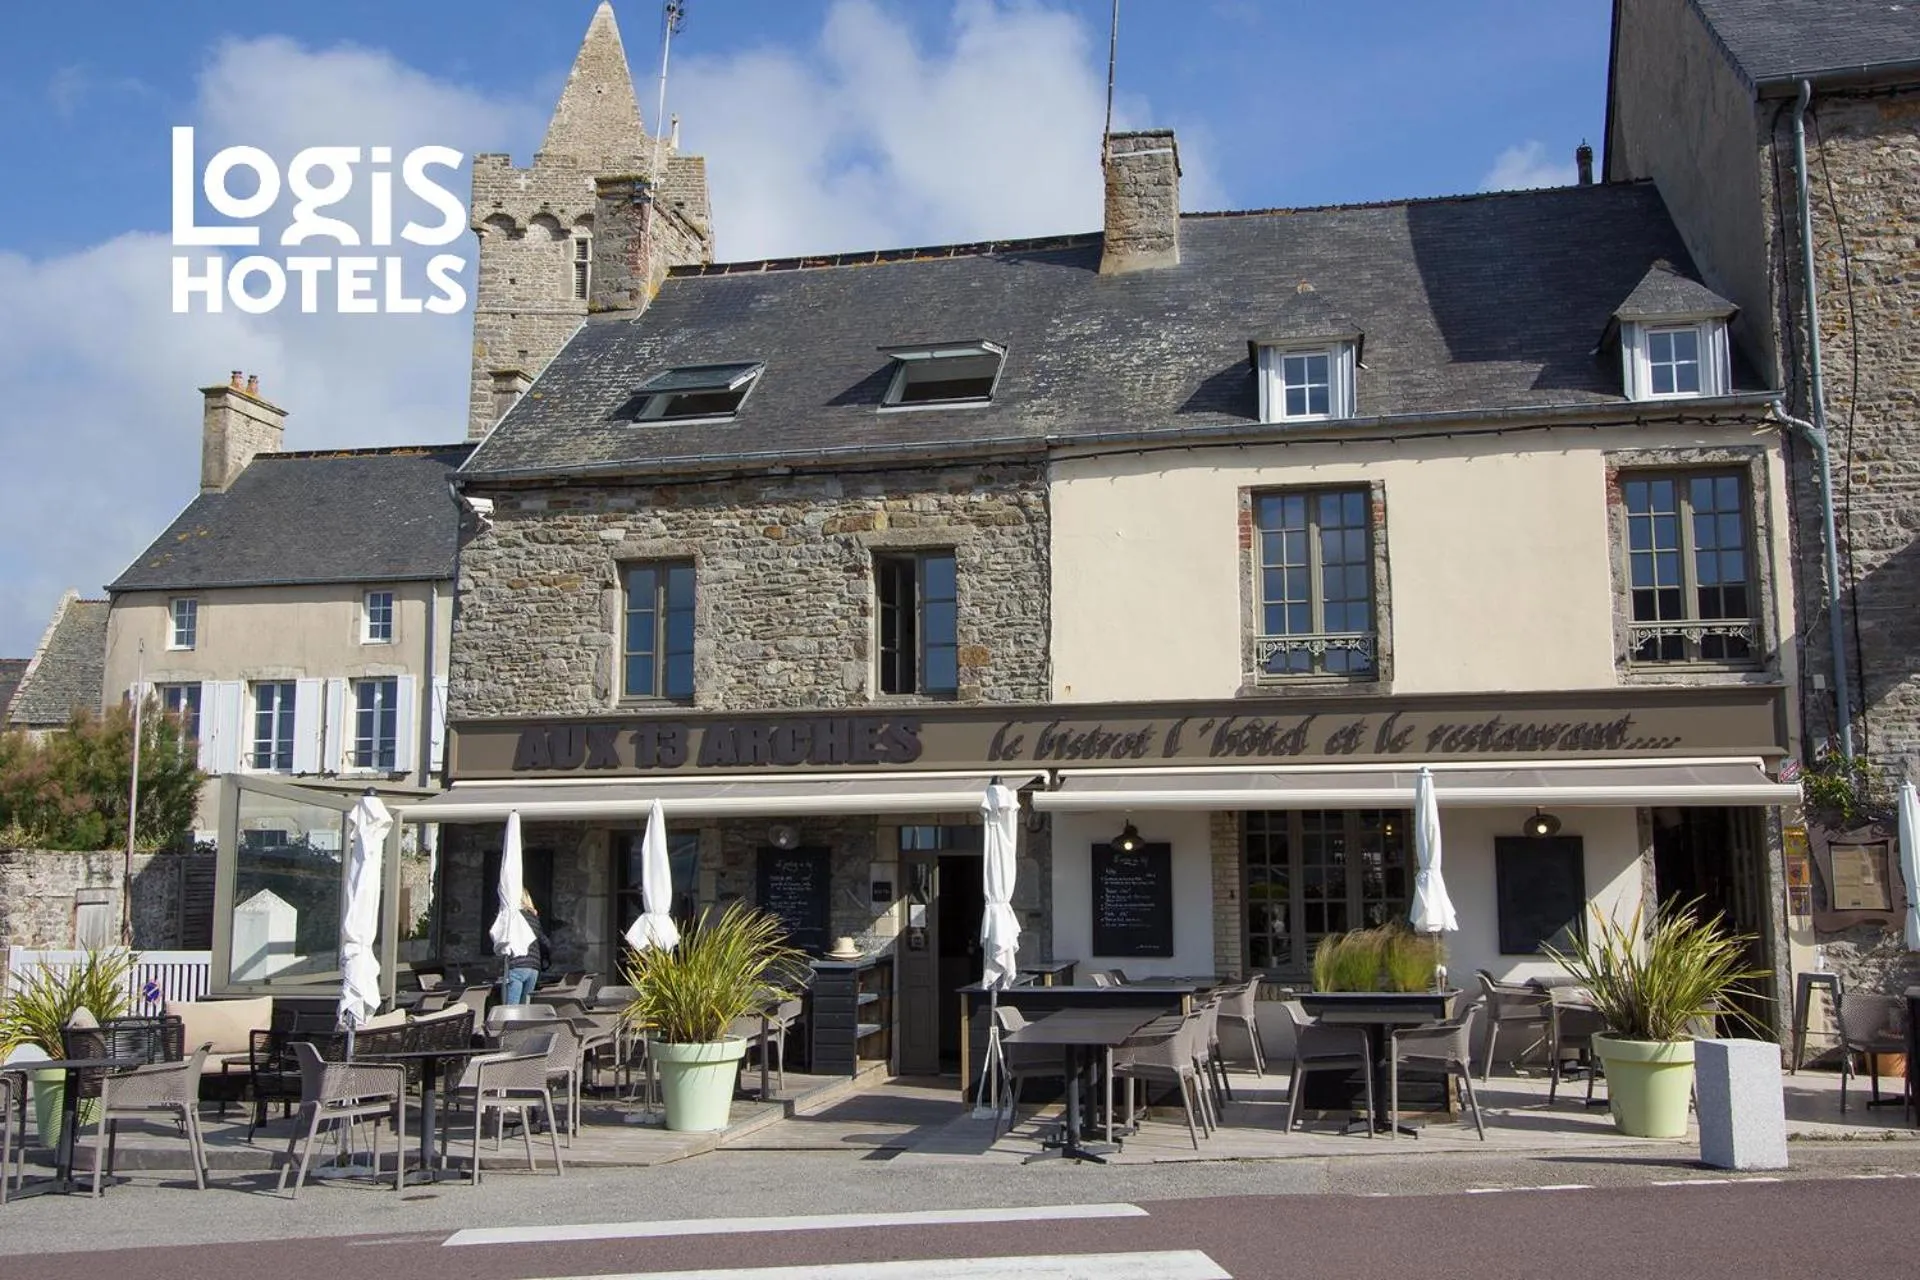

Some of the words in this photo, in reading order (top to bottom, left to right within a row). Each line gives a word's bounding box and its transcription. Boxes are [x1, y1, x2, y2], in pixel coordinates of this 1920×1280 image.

[512, 725, 623, 770] AUX
[629, 724, 690, 769] 13
[696, 717, 923, 766] ARCHES
[987, 719, 1025, 761] le
[1033, 716, 1157, 760] bistrot
[1324, 717, 1368, 755] et
[1374, 710, 1416, 754] le
